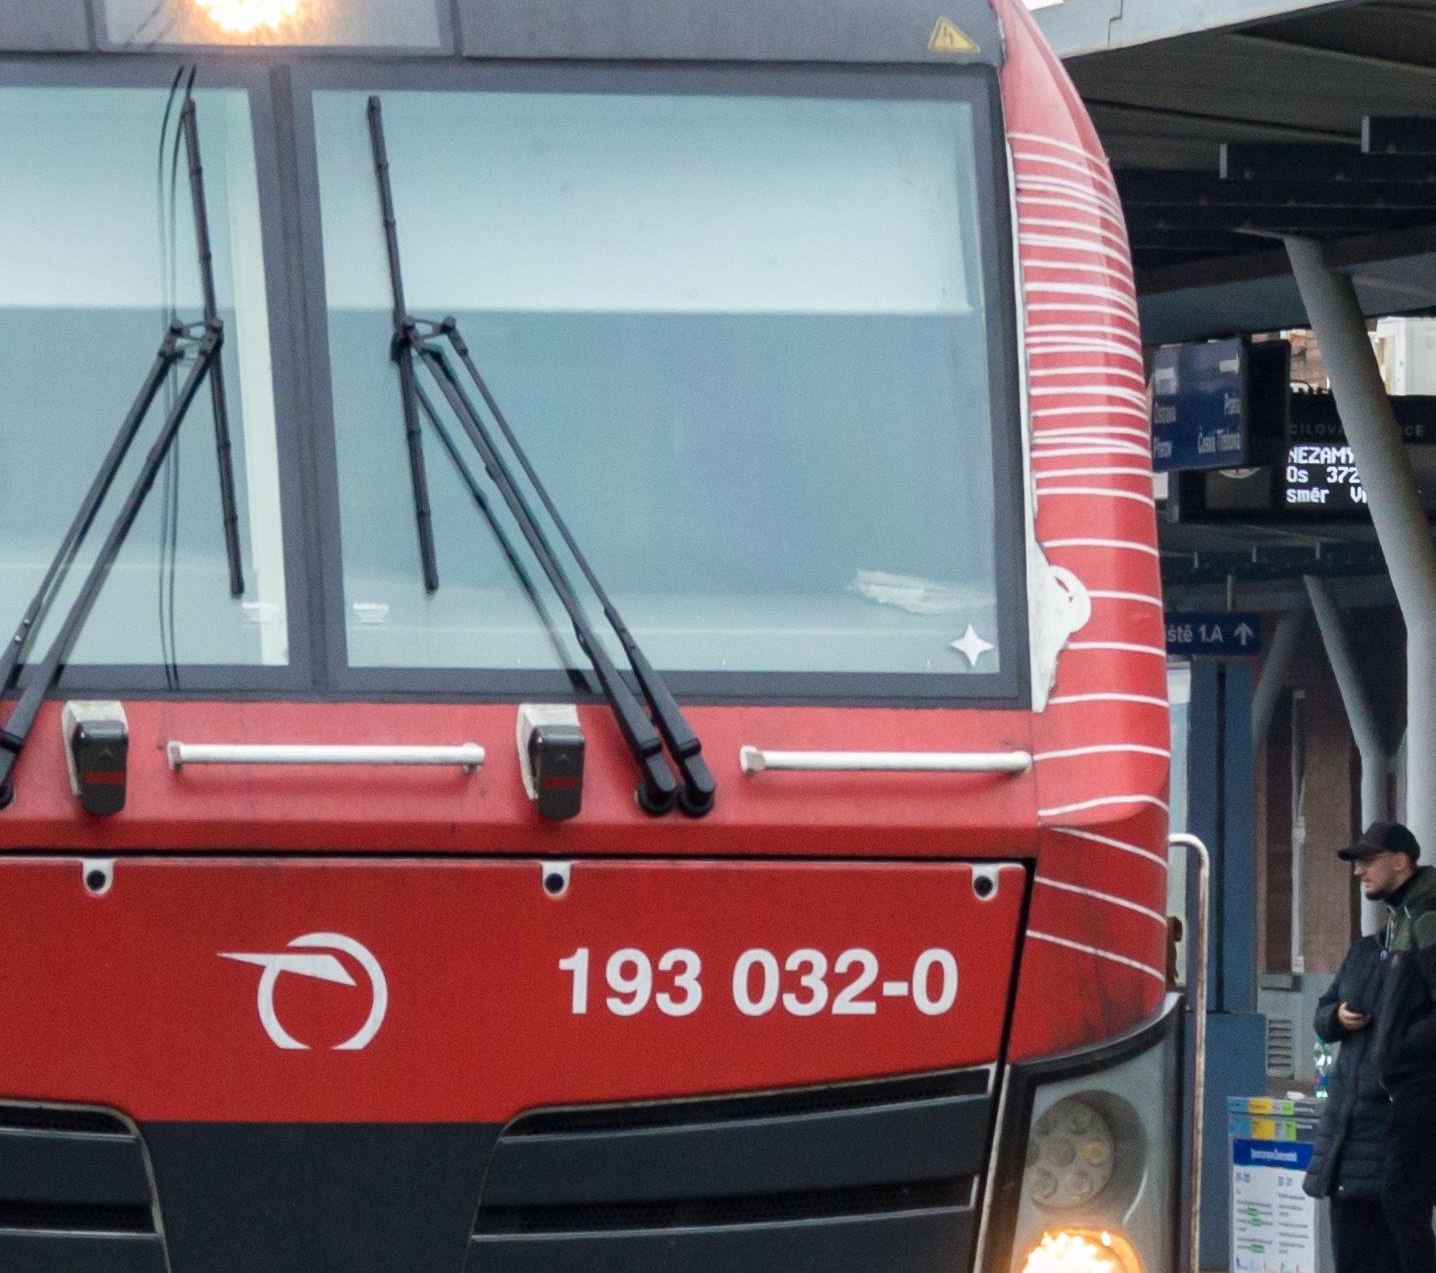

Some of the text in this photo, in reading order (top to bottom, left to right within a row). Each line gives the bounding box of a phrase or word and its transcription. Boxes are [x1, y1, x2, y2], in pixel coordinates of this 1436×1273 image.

[1289, 446, 1354, 464] NEZAMY
[1287, 467, 1361, 484] Os 372
[1287, 487, 1330, 504] směr
[559, 947, 959, 1017] 193 032-0
